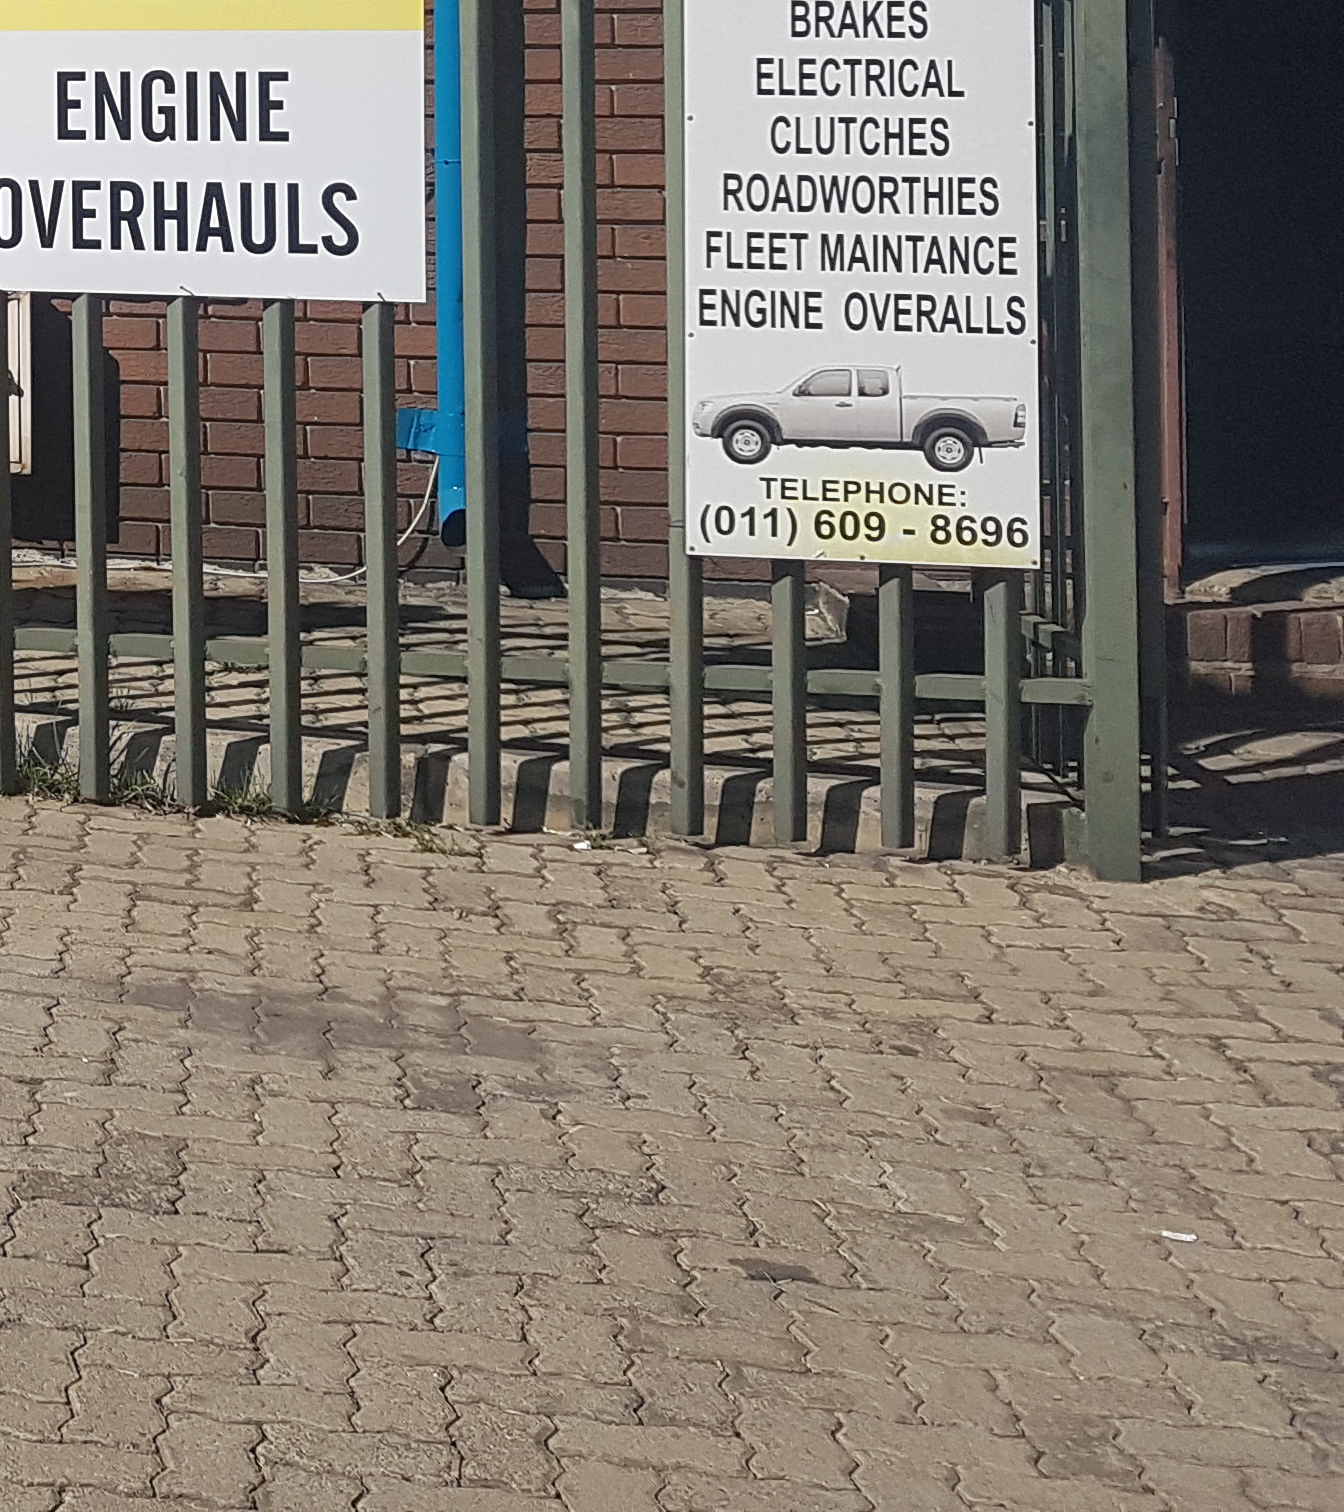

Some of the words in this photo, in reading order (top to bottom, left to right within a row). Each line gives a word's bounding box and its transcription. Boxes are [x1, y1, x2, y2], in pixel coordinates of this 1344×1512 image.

[790, 0, 928, 39] BRAKES
[756, 58, 965, 97] ELECTRICAL
[56, 70, 290, 142] ENGINE
[770, 116, 950, 156] CLUTCHES
[722, 173, 999, 216] ROADWORTHIES
[706, 231, 809, 271] FLEET
[820, 233, 1017, 275] MAINTANCE
[699, 289, 823, 329] ENGINE
[844, 292, 1026, 335] OVERALLS
[759, 477, 967, 507] TELEPHONE:
[700, 504, 798, 546] (011)
[814, 510, 886, 542] 609
[930, 514, 1029, 548] 8696
